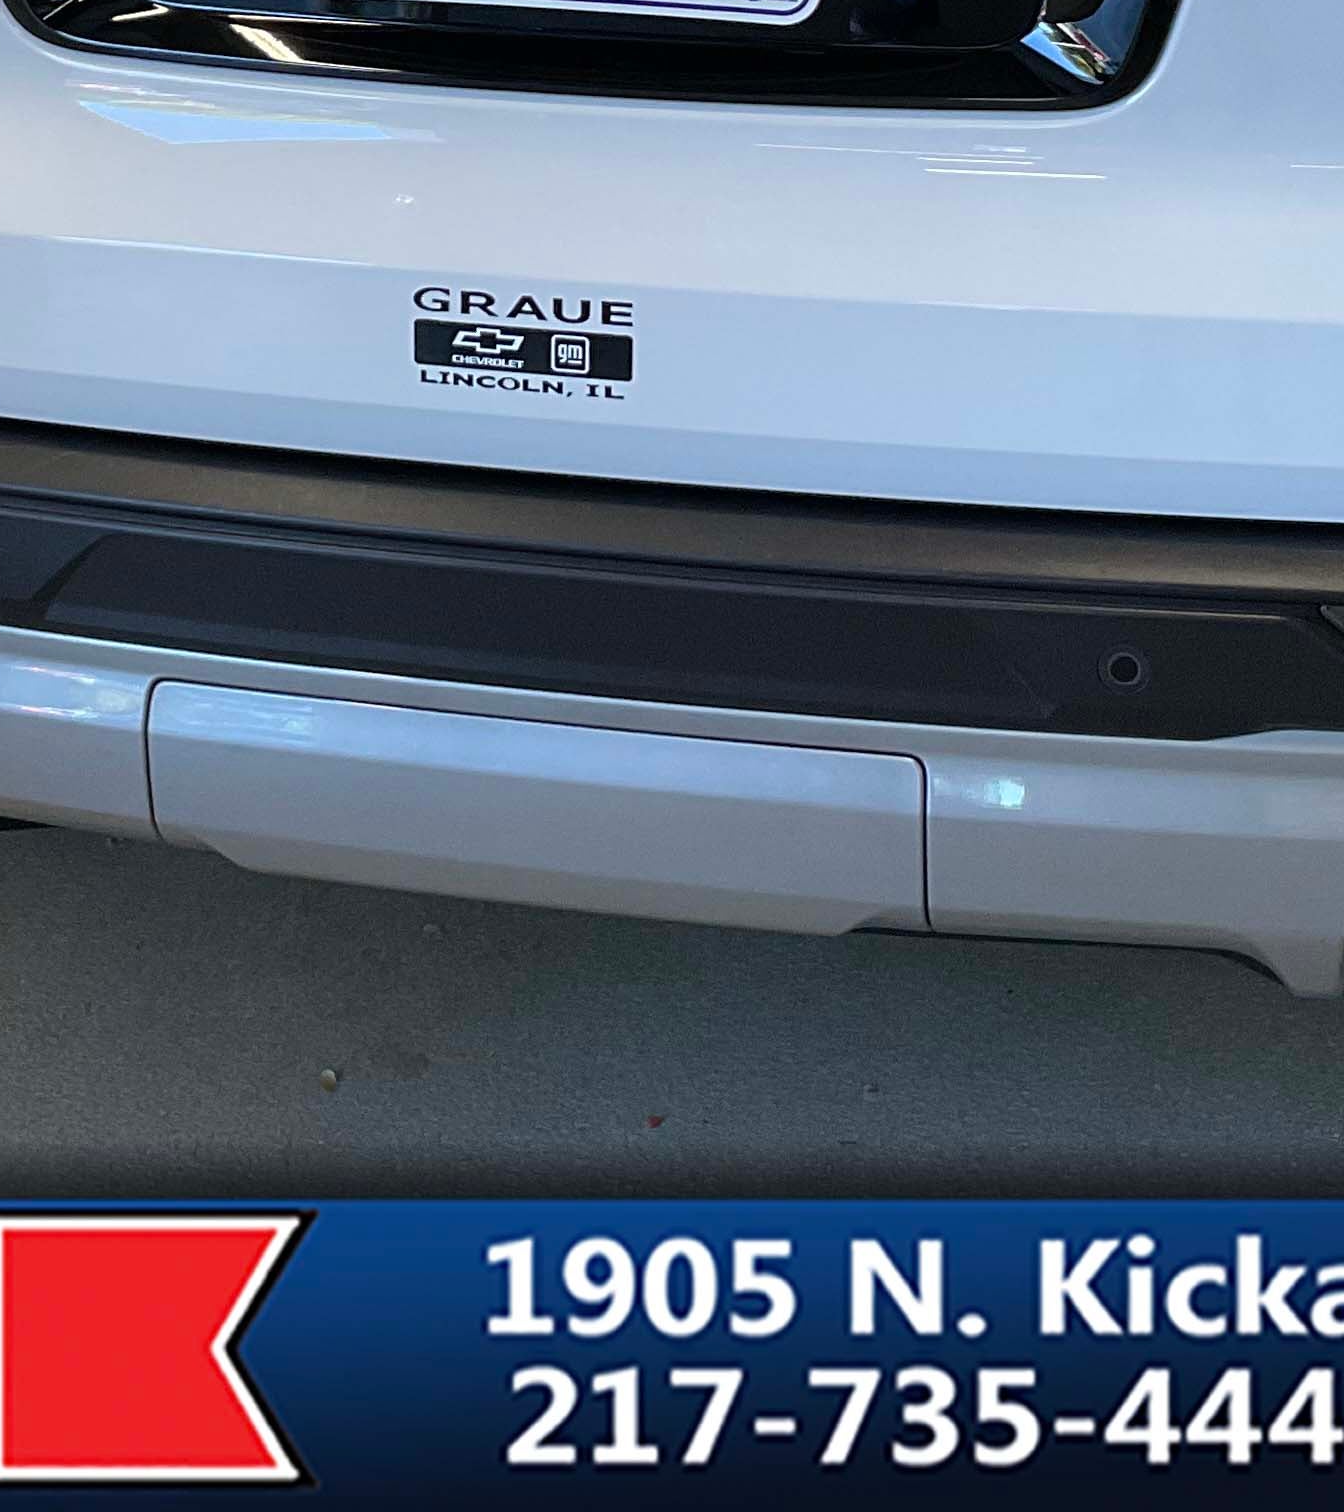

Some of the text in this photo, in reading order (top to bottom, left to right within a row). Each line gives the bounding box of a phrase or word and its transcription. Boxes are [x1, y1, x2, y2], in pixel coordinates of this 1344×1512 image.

[413, 287, 633, 326] GRAUE
[451, 353, 525, 369] CHEVROLET
[557, 343, 583, 365] gm
[420, 370, 624, 400] LINCOLN, IL
